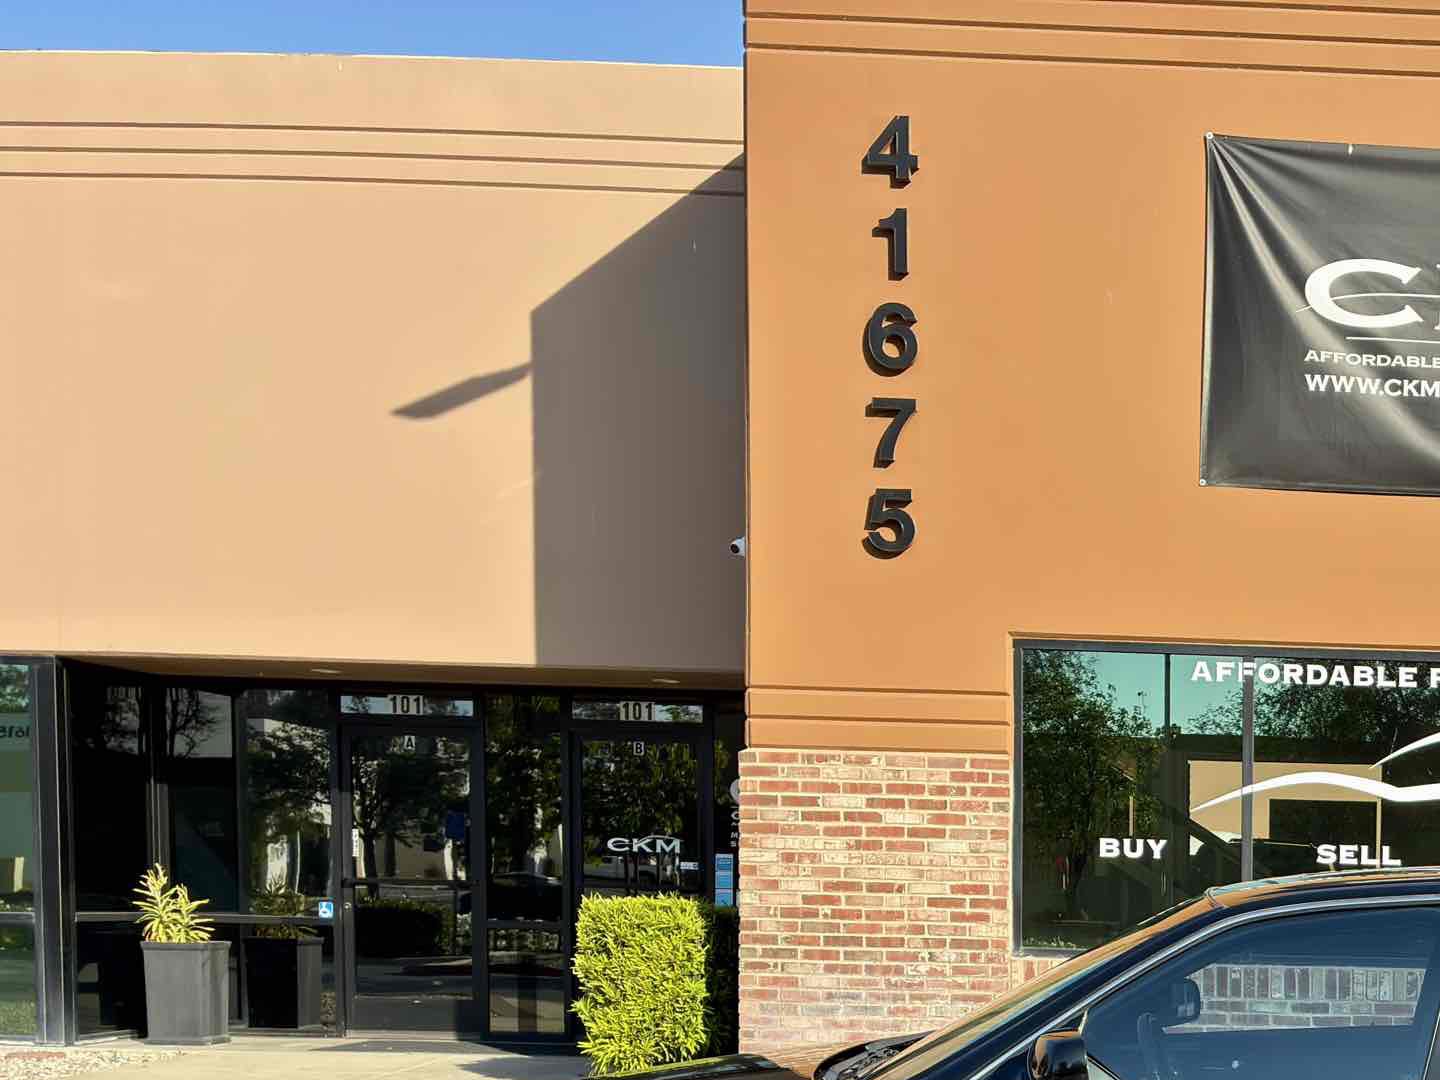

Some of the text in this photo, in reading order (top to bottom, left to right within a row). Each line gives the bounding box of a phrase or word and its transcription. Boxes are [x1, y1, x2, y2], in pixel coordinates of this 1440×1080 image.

[861, 115, 919, 560] 41675
[1191, 660, 1417, 688] AFFORDABLE
[391, 695, 423, 715] 101
[622, 701, 653, 721] 101
[405, 736, 415, 750] A
[635, 742, 644, 755] B
[607, 836, 681, 854] CKM
[1099, 837, 1168, 859] BUY
[1316, 844, 1402, 866] SELL
